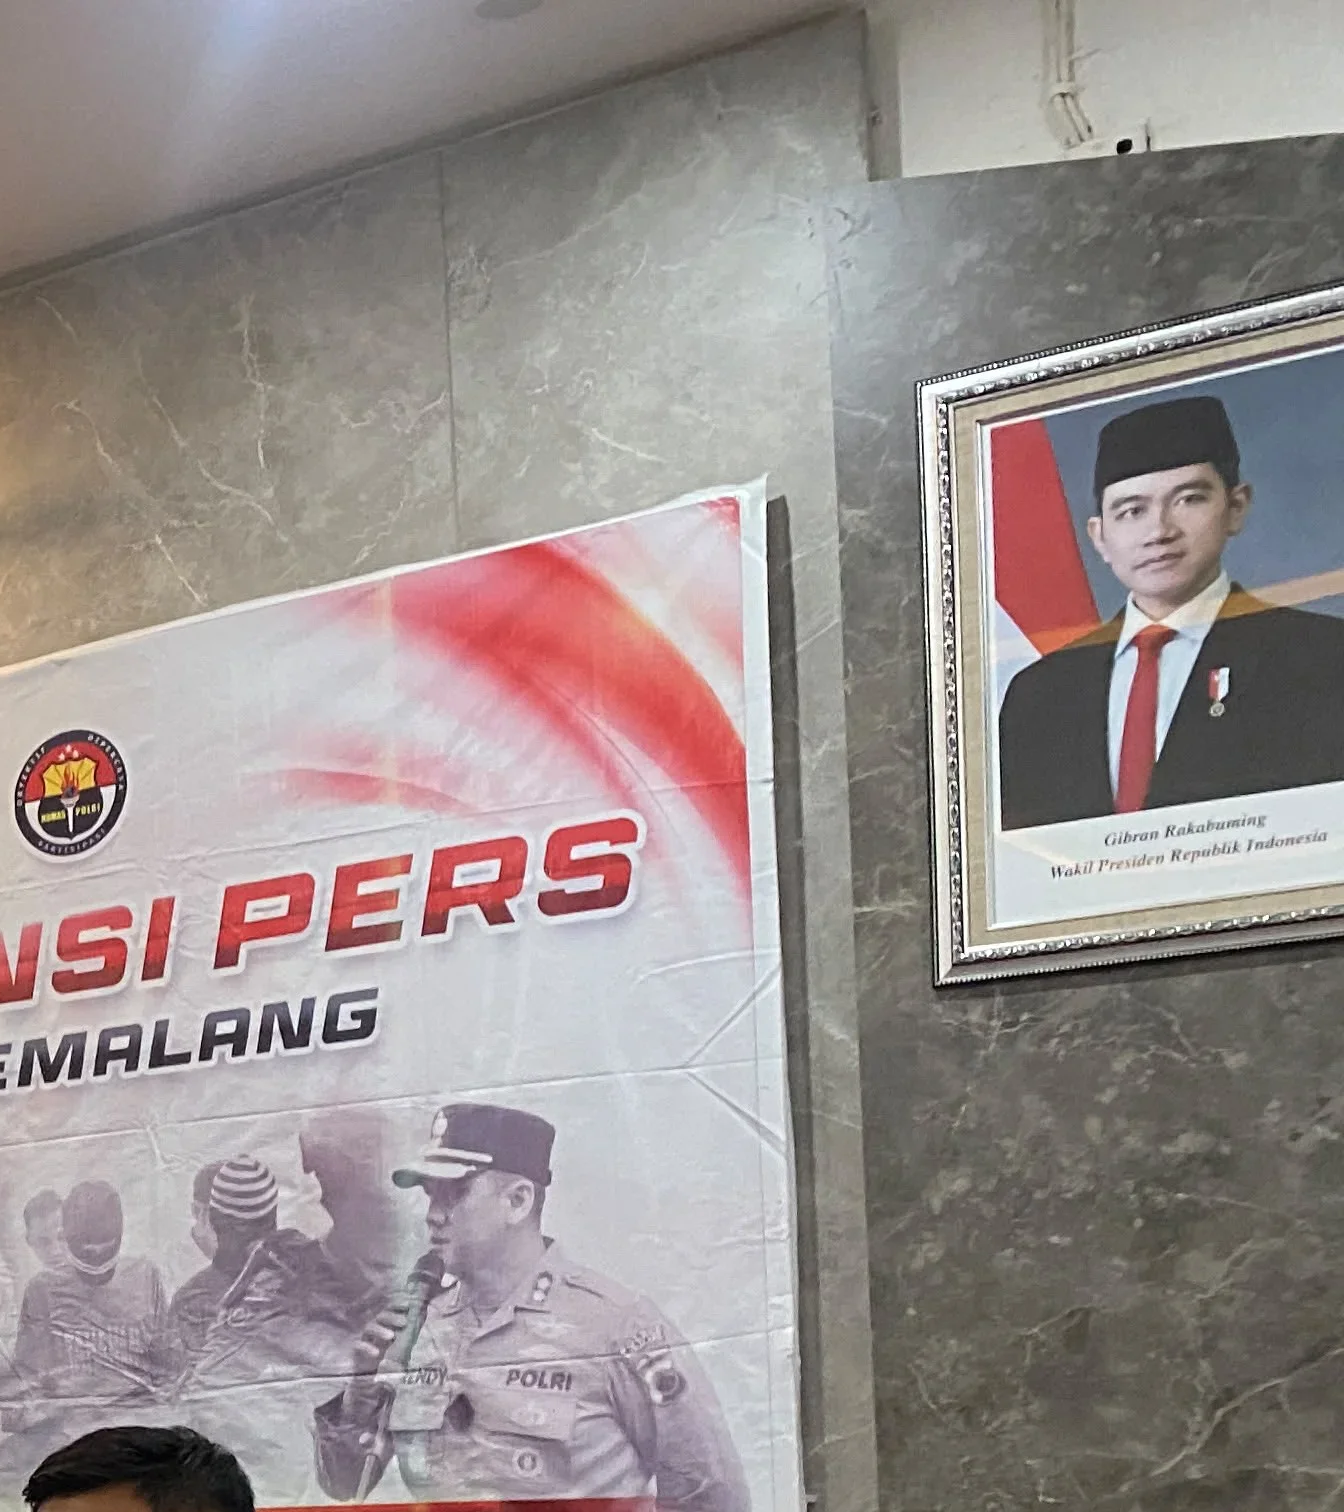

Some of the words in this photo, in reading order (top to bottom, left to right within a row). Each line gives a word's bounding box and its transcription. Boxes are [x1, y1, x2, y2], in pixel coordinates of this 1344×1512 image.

[1104, 831, 1159, 848] Gibran
[1164, 813, 1267, 839] Rakabuming
[1050, 860, 1094, 880] Wakil
[1098, 854, 1165, 873] Presiden
[1170, 842, 1241, 863] Republik
[1246, 828, 1329, 851] Indonesia
[212, 816, 639, 971] PERS
[505, 1368, 572, 1392] POLRI
